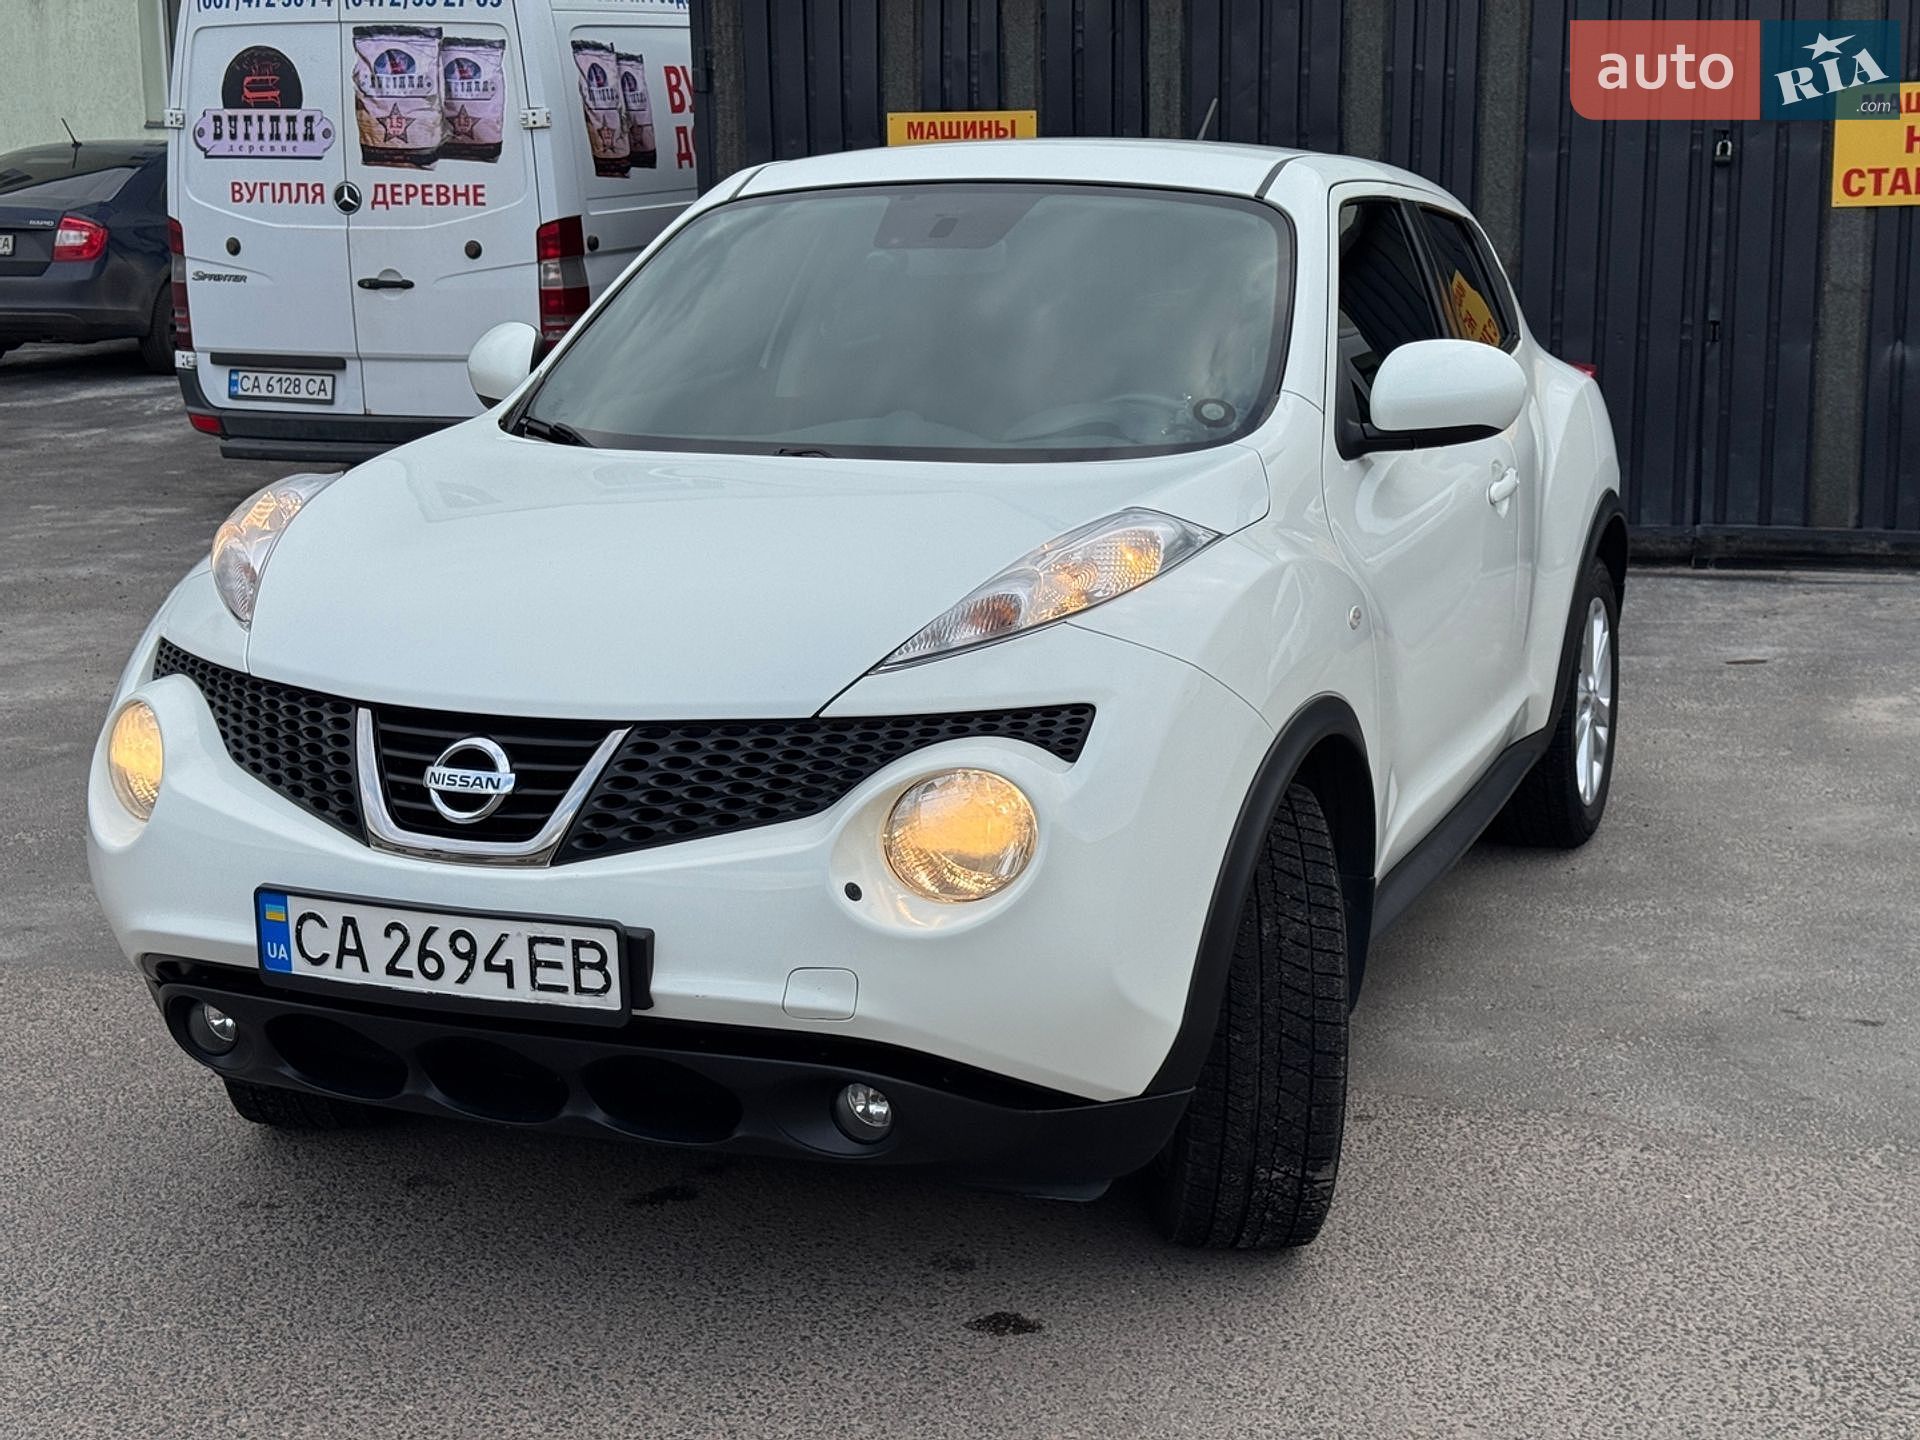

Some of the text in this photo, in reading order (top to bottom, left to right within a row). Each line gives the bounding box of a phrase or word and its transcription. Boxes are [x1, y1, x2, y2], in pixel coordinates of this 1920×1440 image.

[213, 115, 315, 141] ВУГІЛЛЯ
[907, 119, 1016, 140] МАШИНЫ
[1842, 167, 1920, 197] СТА
[230, 182, 487, 210] ВУГІЛЛЯ ДЕРЕВНЕ
[240, 375, 328, 397] CA 6128 CA
[429, 770, 501, 791] NISSAN
[267, 941, 288, 961] UA
[295, 911, 612, 997] CA 2694 EB
